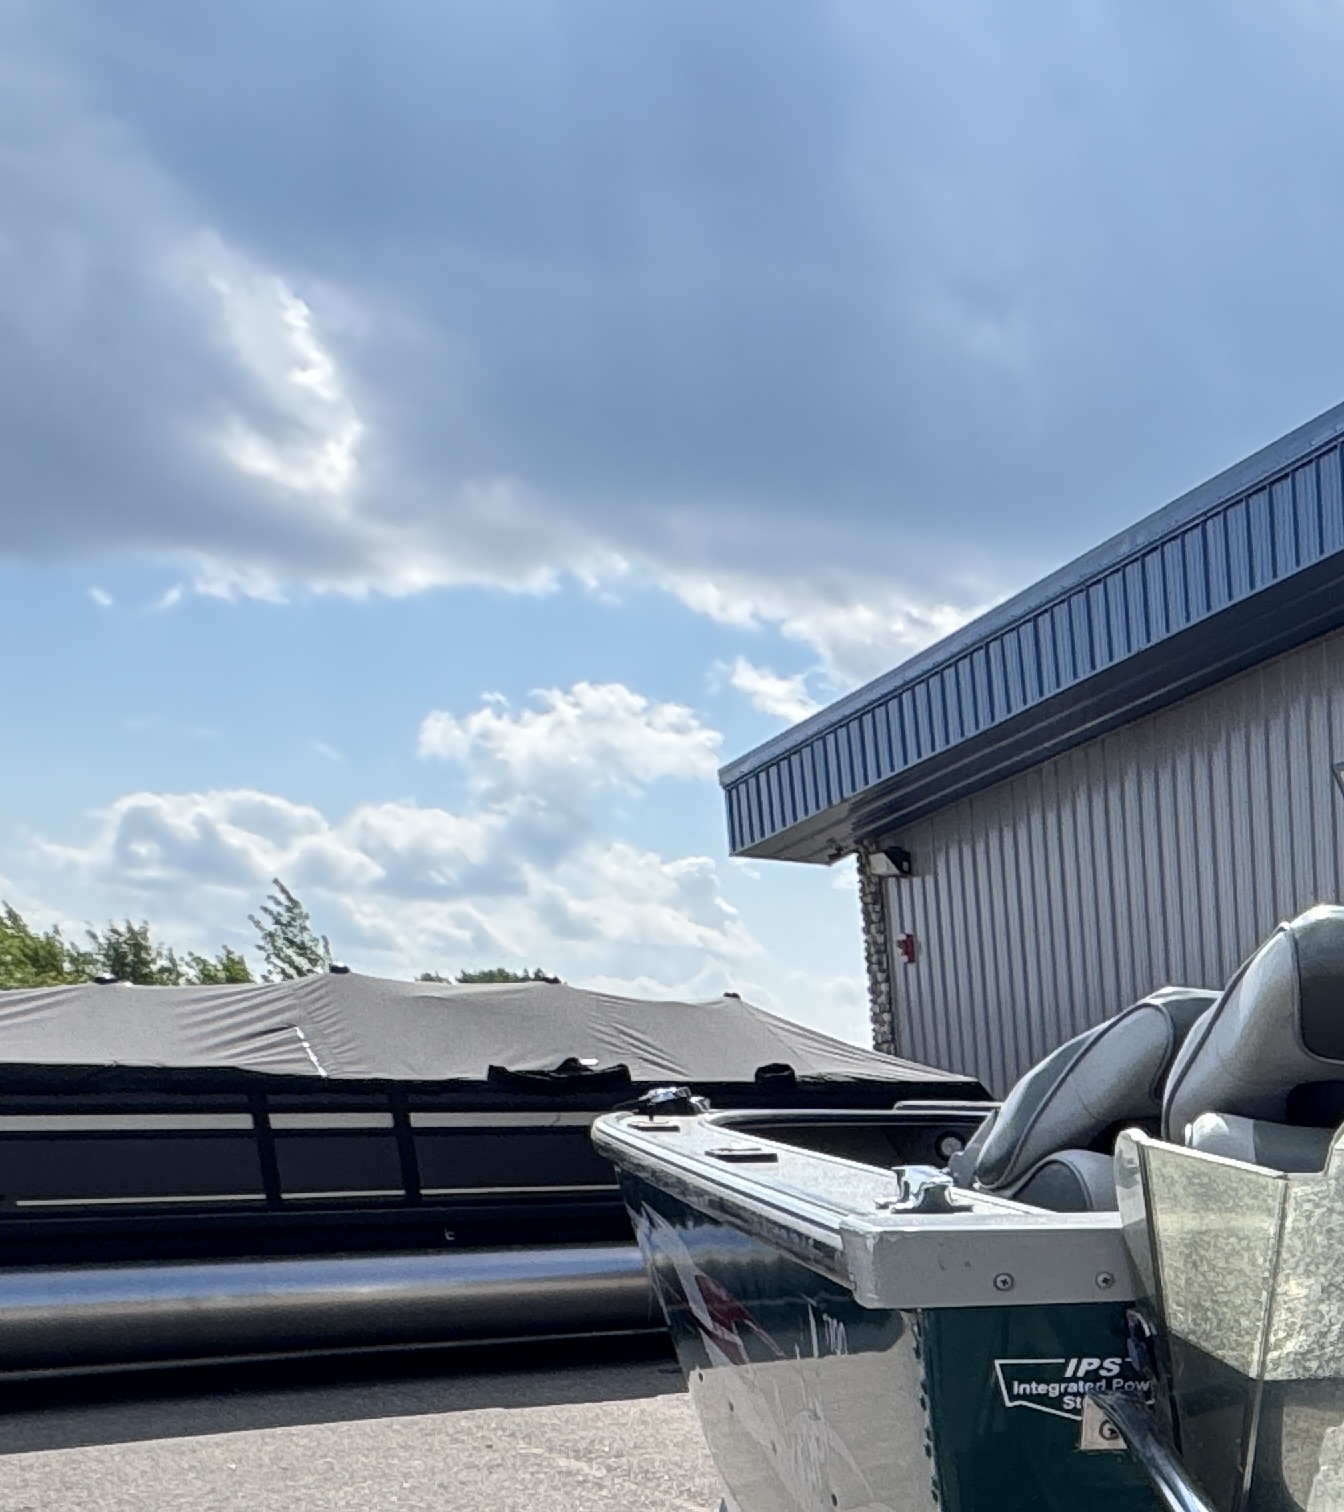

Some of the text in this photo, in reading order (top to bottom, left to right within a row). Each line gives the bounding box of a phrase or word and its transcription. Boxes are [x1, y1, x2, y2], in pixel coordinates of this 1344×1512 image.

[1064, 1357, 1123, 1378] IPS
[1012, 1378, 1150, 1397] Integrated Pow
